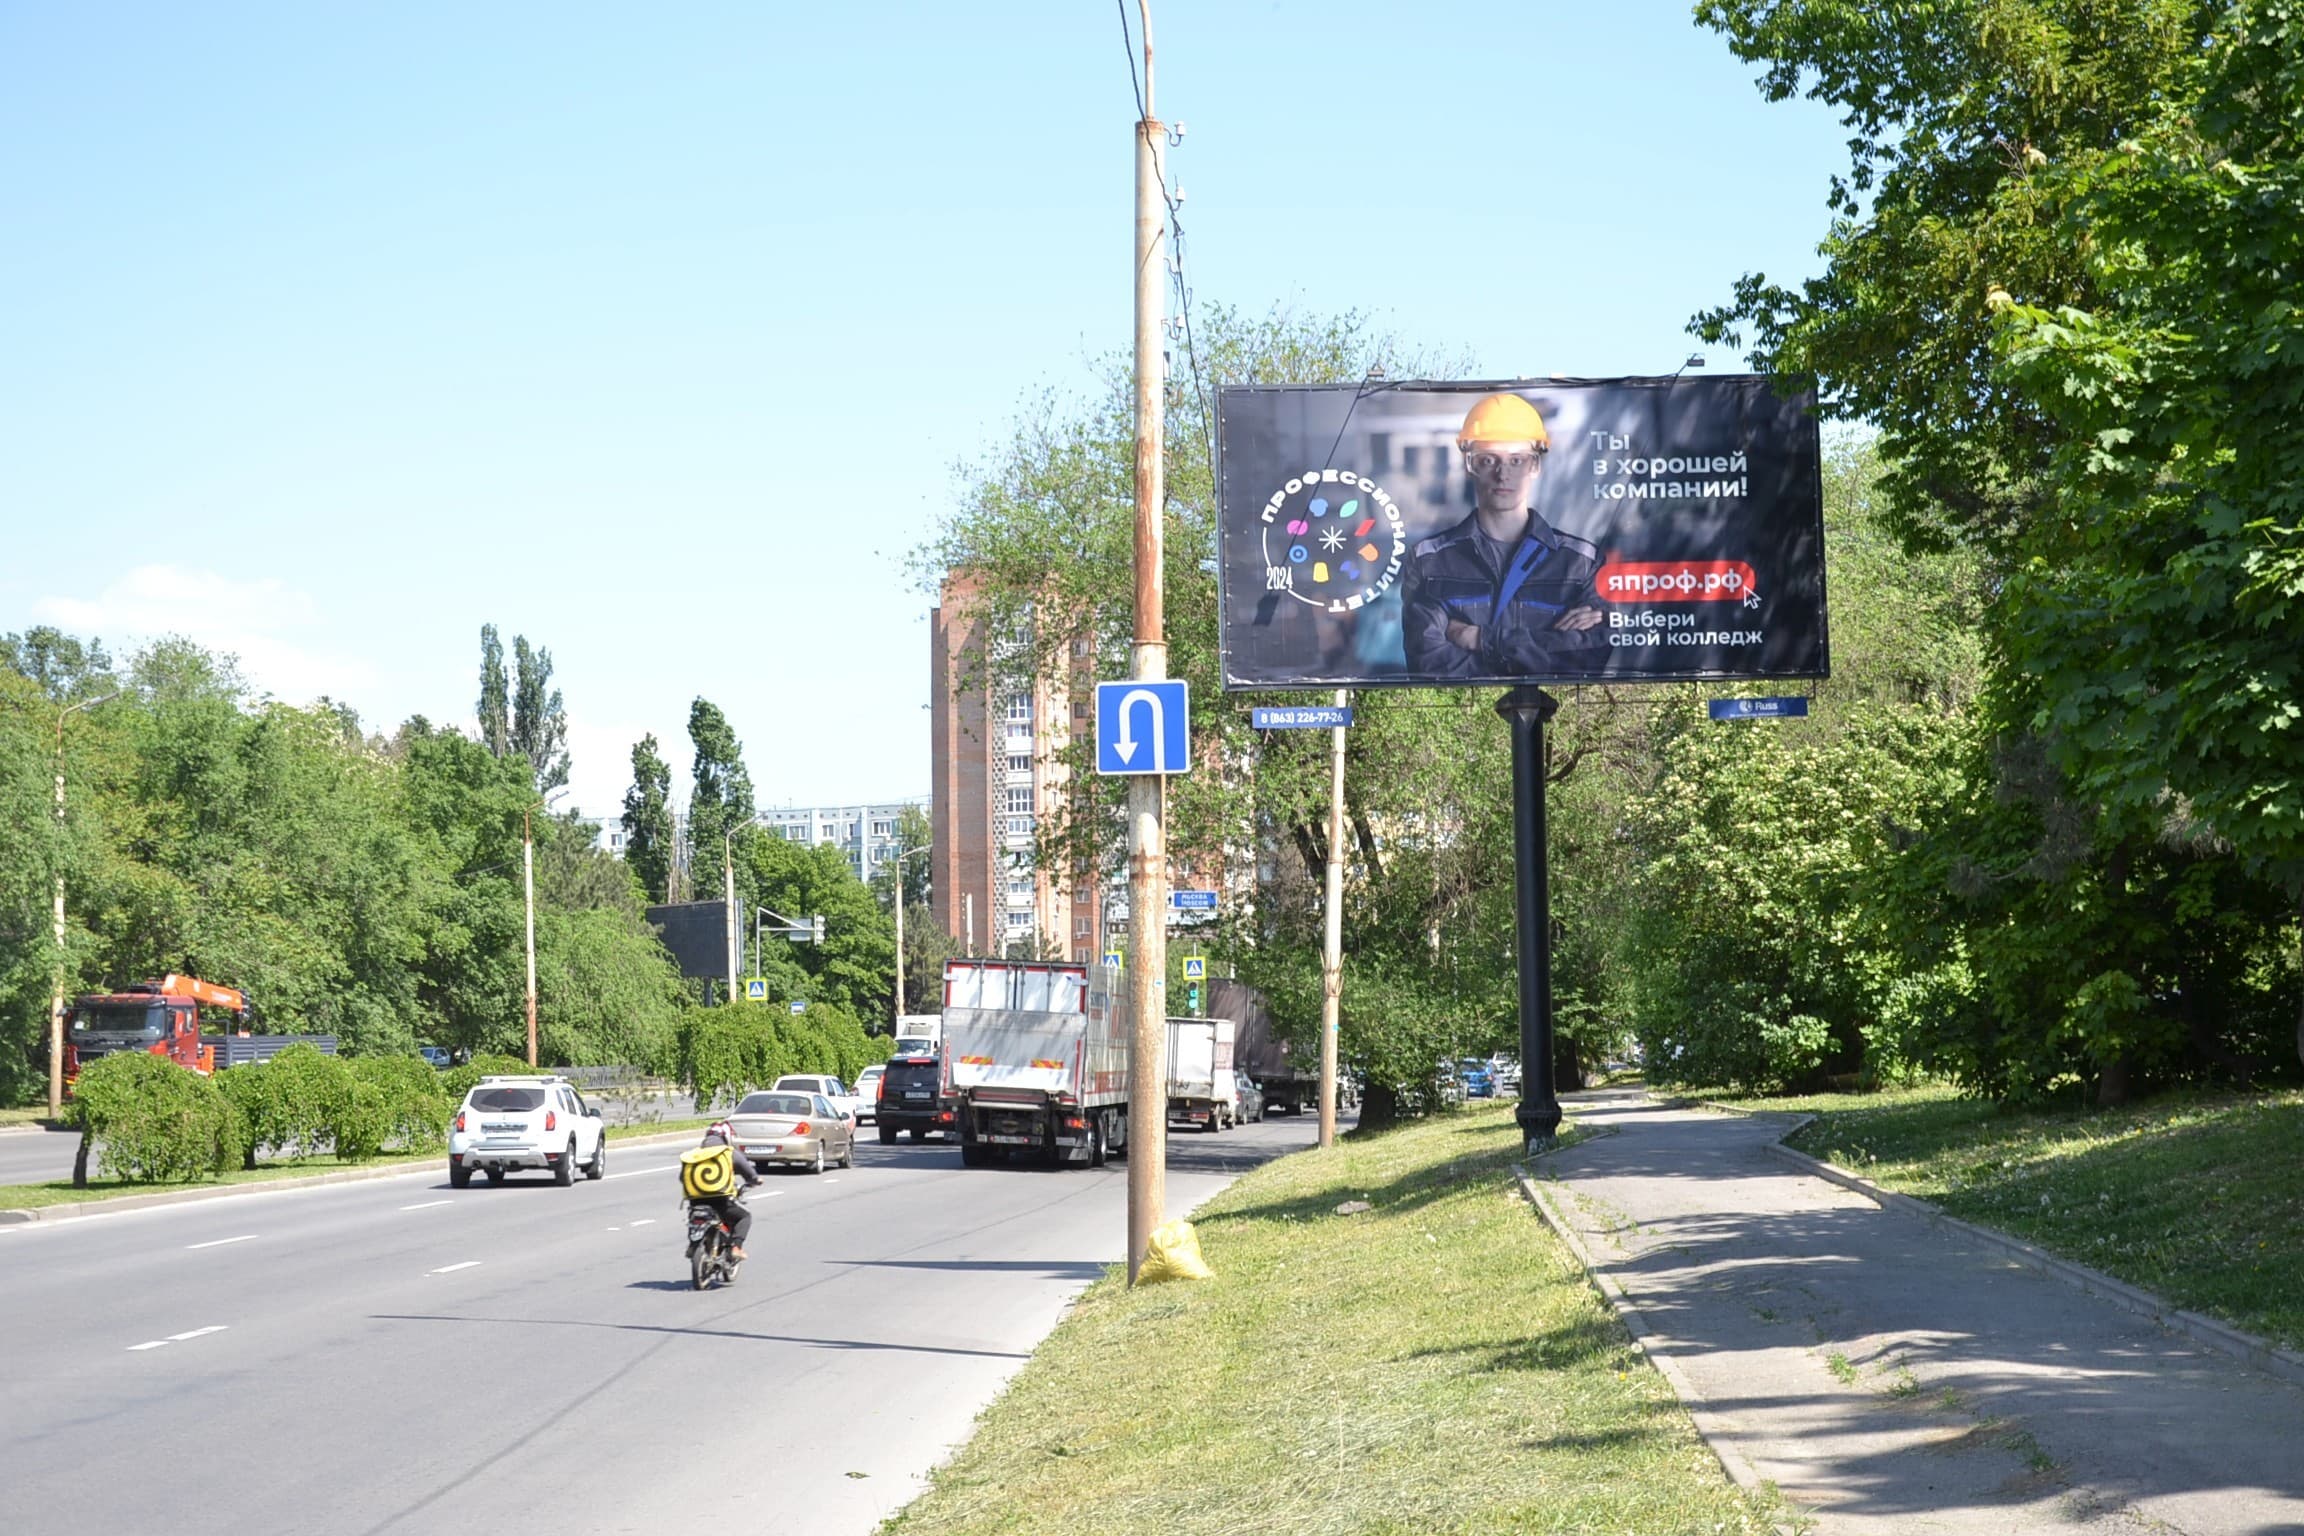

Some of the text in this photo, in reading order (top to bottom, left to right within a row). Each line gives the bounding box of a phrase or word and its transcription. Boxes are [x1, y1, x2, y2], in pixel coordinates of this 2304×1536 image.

[1590, 431, 1630, 450] Ты
[1593, 450, 1747, 479] в хорошей
[1593, 476, 1748, 499] компании!
[1261, 469, 1406, 613] ПРОФЕССИОНАЛИТЕТ
[1266, 566, 1293, 590] 2024
[1608, 569, 1743, 595] япроф.рф
[1609, 610, 1695, 630] Выбери
[1609, 629, 1763, 647] свой колледж
[1755, 702, 1779, 711] Russ
[1261, 711, 1344, 724] 8 (863) 226-77-26
